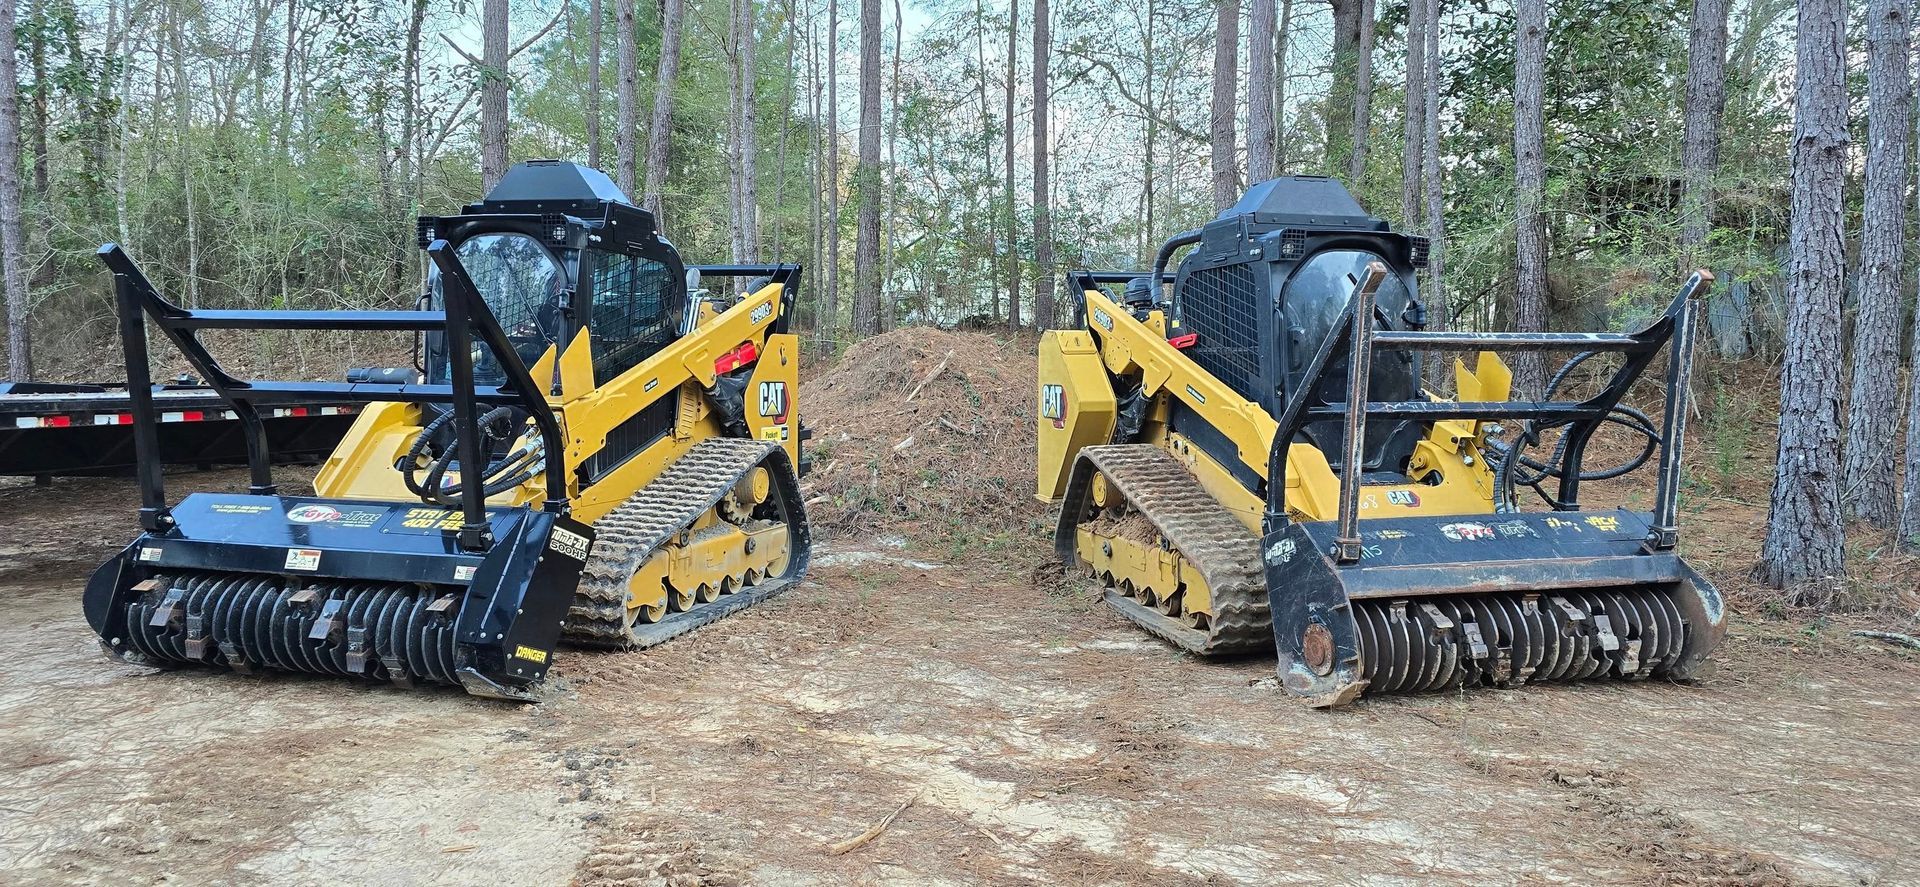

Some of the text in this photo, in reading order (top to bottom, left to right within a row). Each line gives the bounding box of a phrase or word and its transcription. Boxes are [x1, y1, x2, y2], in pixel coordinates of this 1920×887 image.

[759, 382, 785, 417] CAT
[1042, 384, 1063, 418] CAT
[1386, 490, 1412, 505] CAT
[404, 508, 450, 519] STAY
[401, 519, 466, 531] 400 FEE
[515, 645, 547, 664] DANGER
